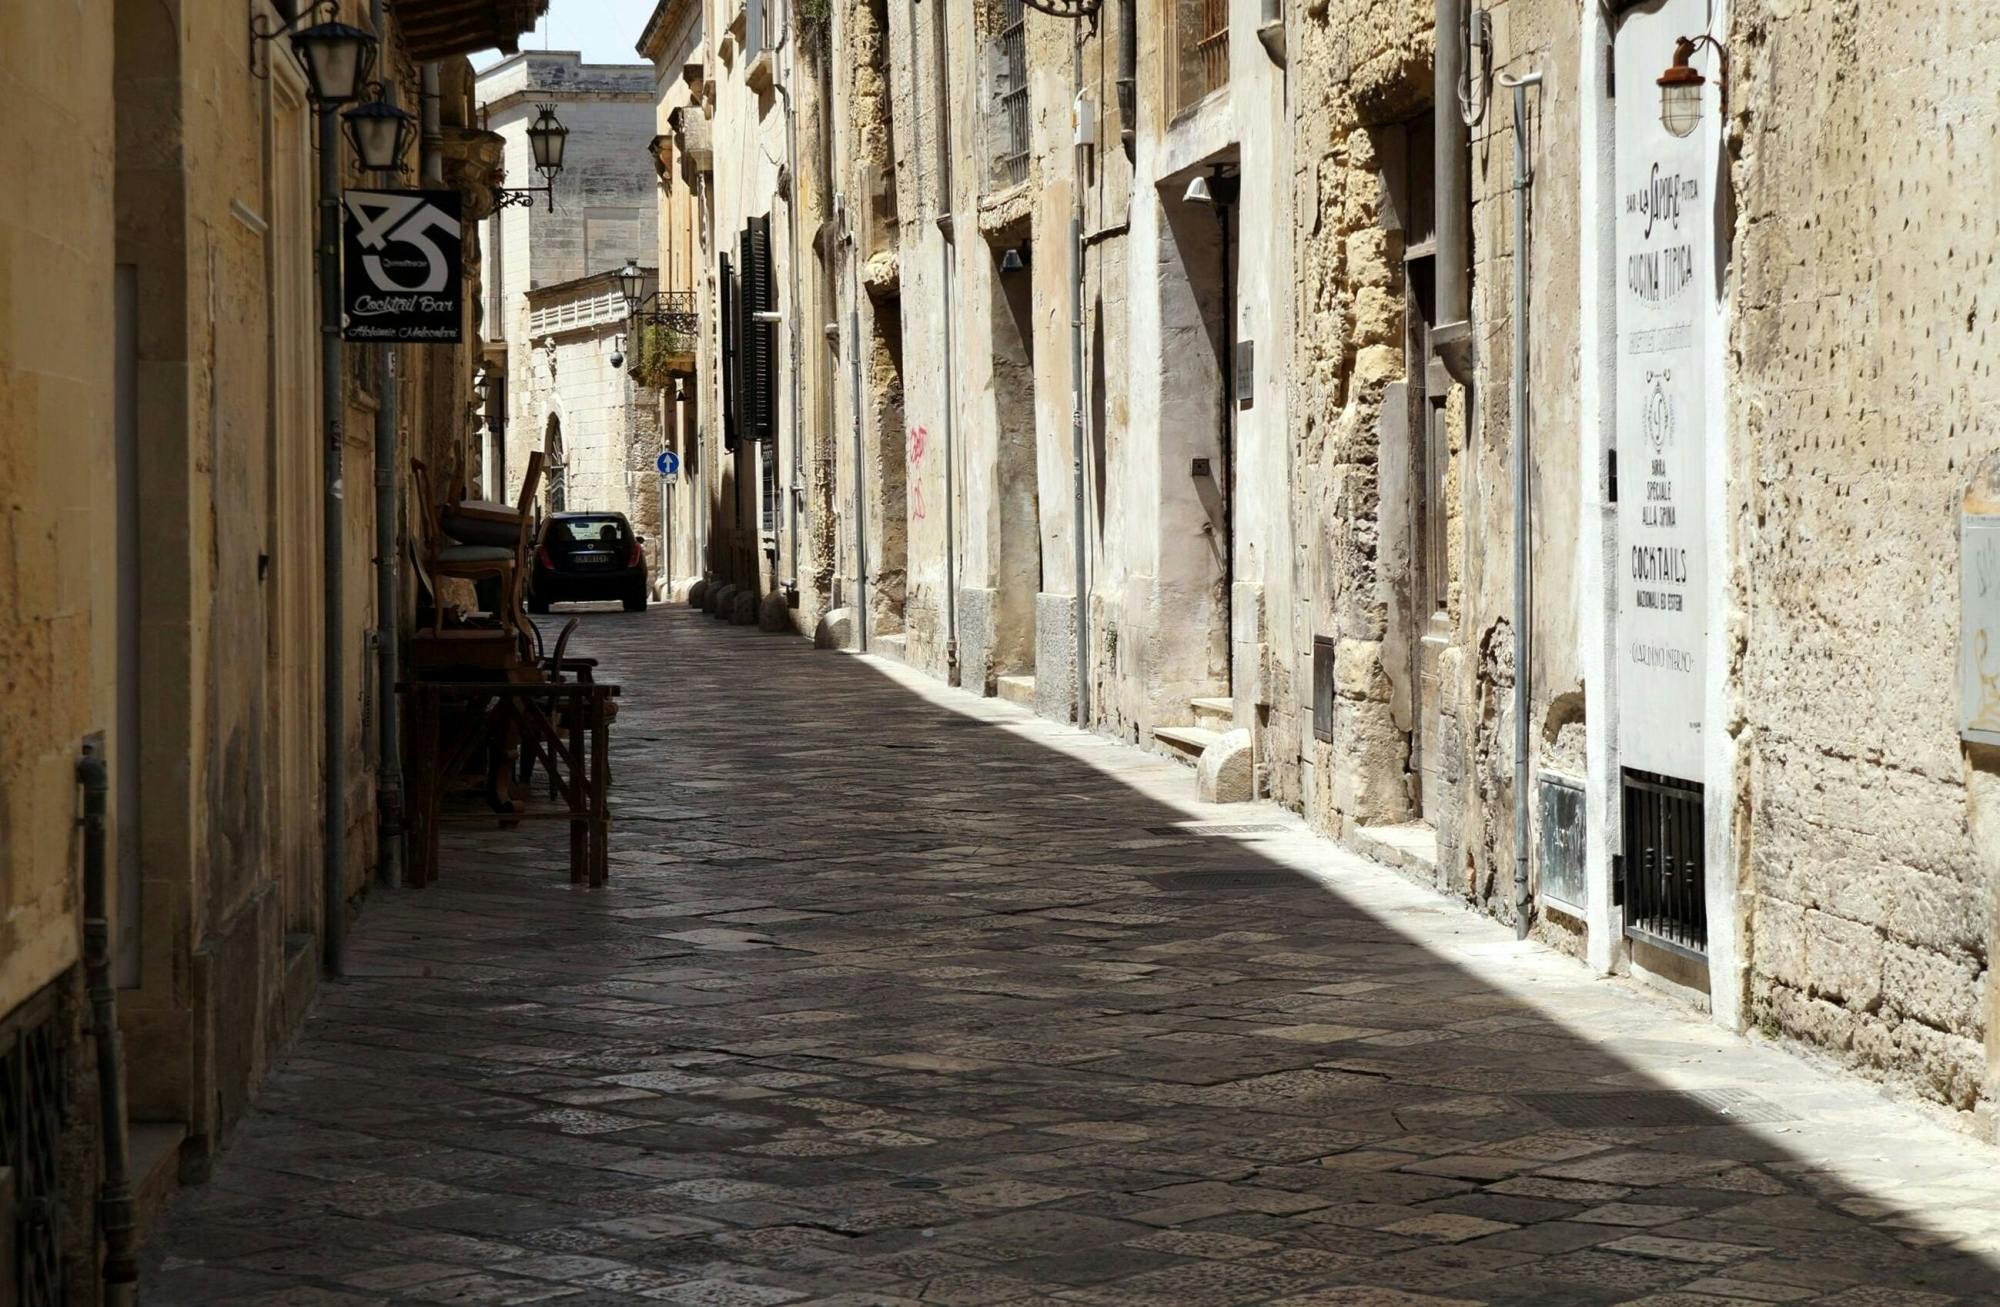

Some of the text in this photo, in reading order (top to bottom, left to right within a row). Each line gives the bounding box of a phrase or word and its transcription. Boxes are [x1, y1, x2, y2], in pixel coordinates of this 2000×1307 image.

[1639, 189, 1649, 215] LA
[344, 191, 460, 292] 45
[1628, 244, 1693, 302] CUCINA TIPICA
[352, 294, 454, 316] Cocktail Bar
[1647, 481, 1671, 501] SPECIALE
[1642, 505, 1677, 528] ALLA SPINA
[1631, 544, 1687, 583] COCKTAILS
